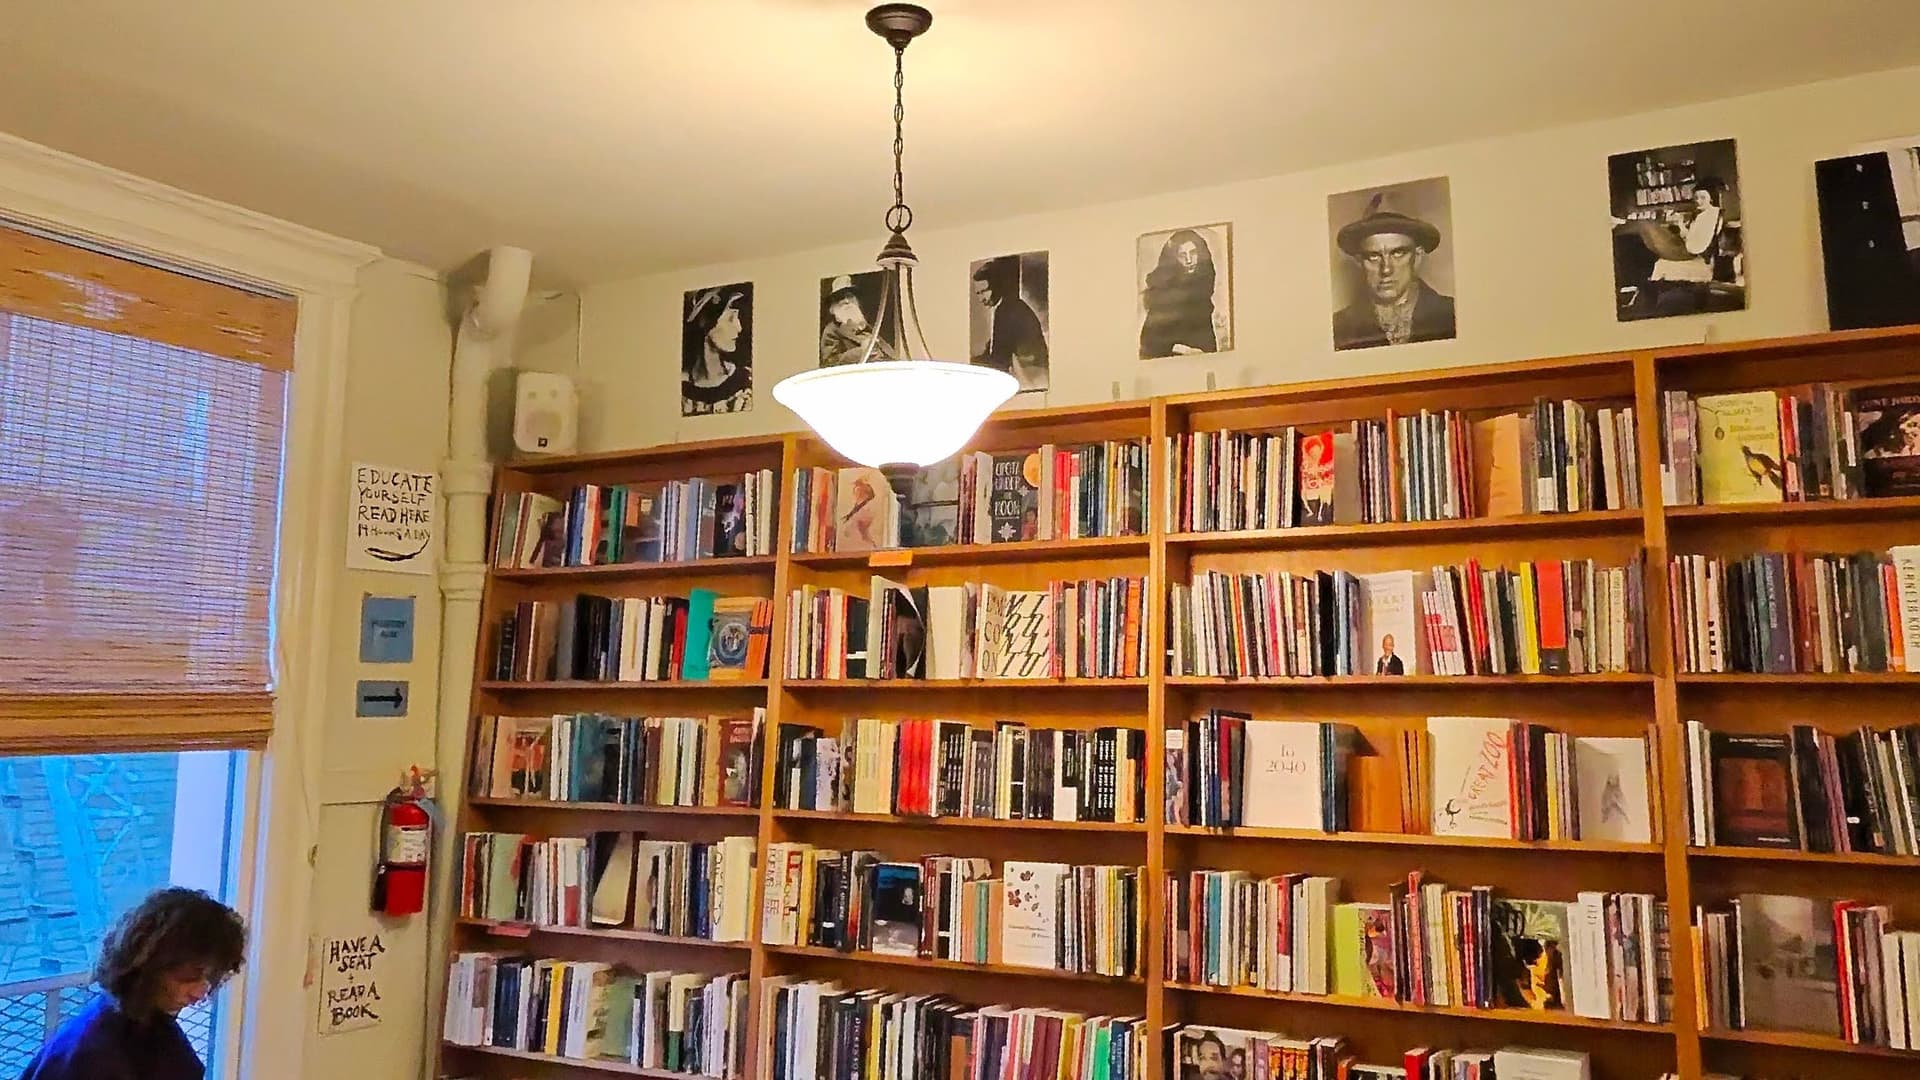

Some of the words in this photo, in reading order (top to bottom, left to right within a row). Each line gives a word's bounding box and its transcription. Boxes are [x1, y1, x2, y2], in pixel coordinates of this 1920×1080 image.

[357, 467, 433, 494] EDUCATE
[357, 485, 427, 506] YOURSELF
[358, 505, 397, 523] READ
[400, 507, 430, 526] HERE
[1265, 759, 1306, 774] 2040
[329, 936, 368, 964] HAVE
[369, 934, 386, 953] A
[338, 952, 377, 973] SEAT
[327, 985, 365, 1007] READ
[367, 981, 381, 1000] A
[330, 1002, 379, 1026] BOOK
